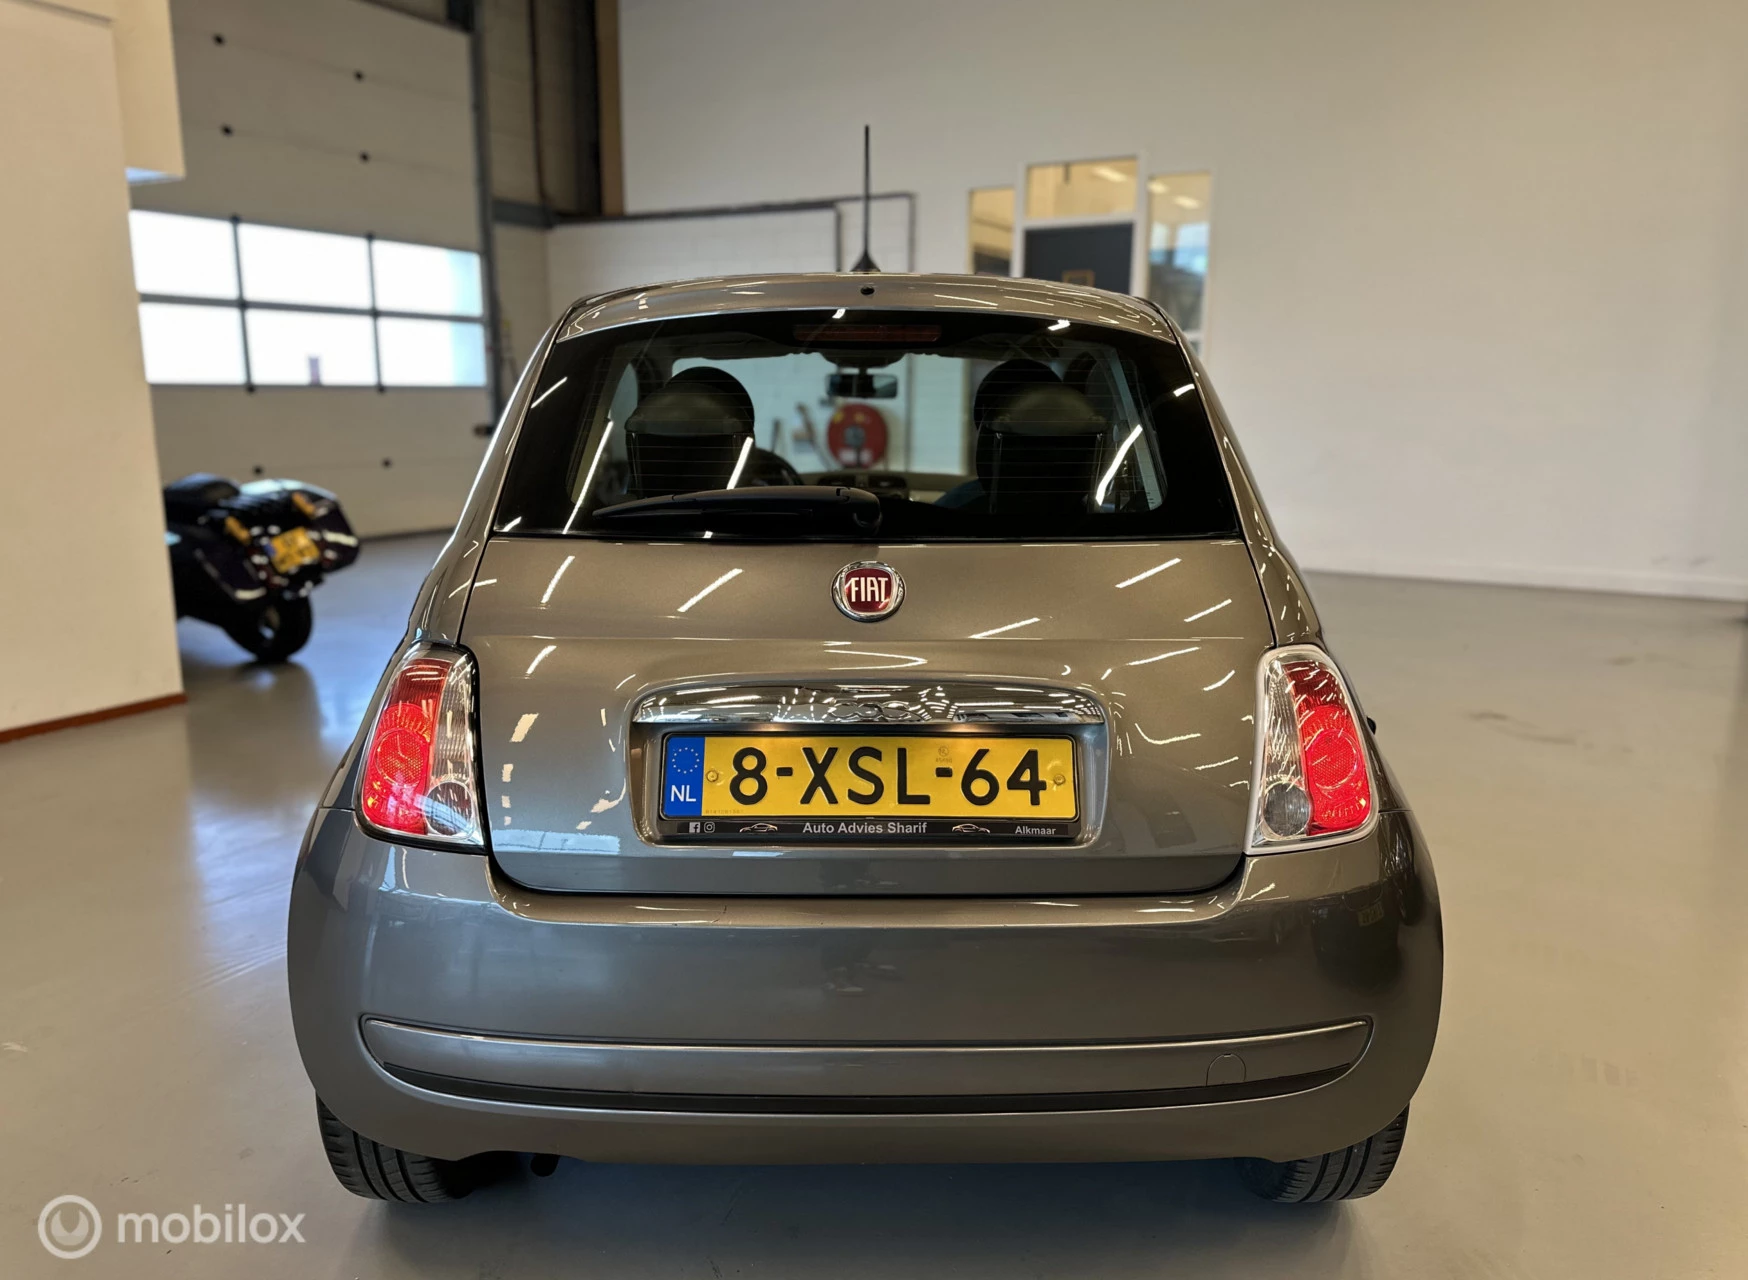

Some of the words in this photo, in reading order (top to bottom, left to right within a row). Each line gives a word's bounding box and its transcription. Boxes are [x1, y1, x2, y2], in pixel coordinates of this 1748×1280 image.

[850, 577, 889, 603] FIAT
[728, 746, 1049, 806] 8-XSL-64
[670, 784, 697, 802] NL
[802, 822, 835, 834] Auto
[837, 822, 883, 834] Advies
[887, 822, 928, 834] Sharif
[1014, 825, 1057, 835] Alkmaar
